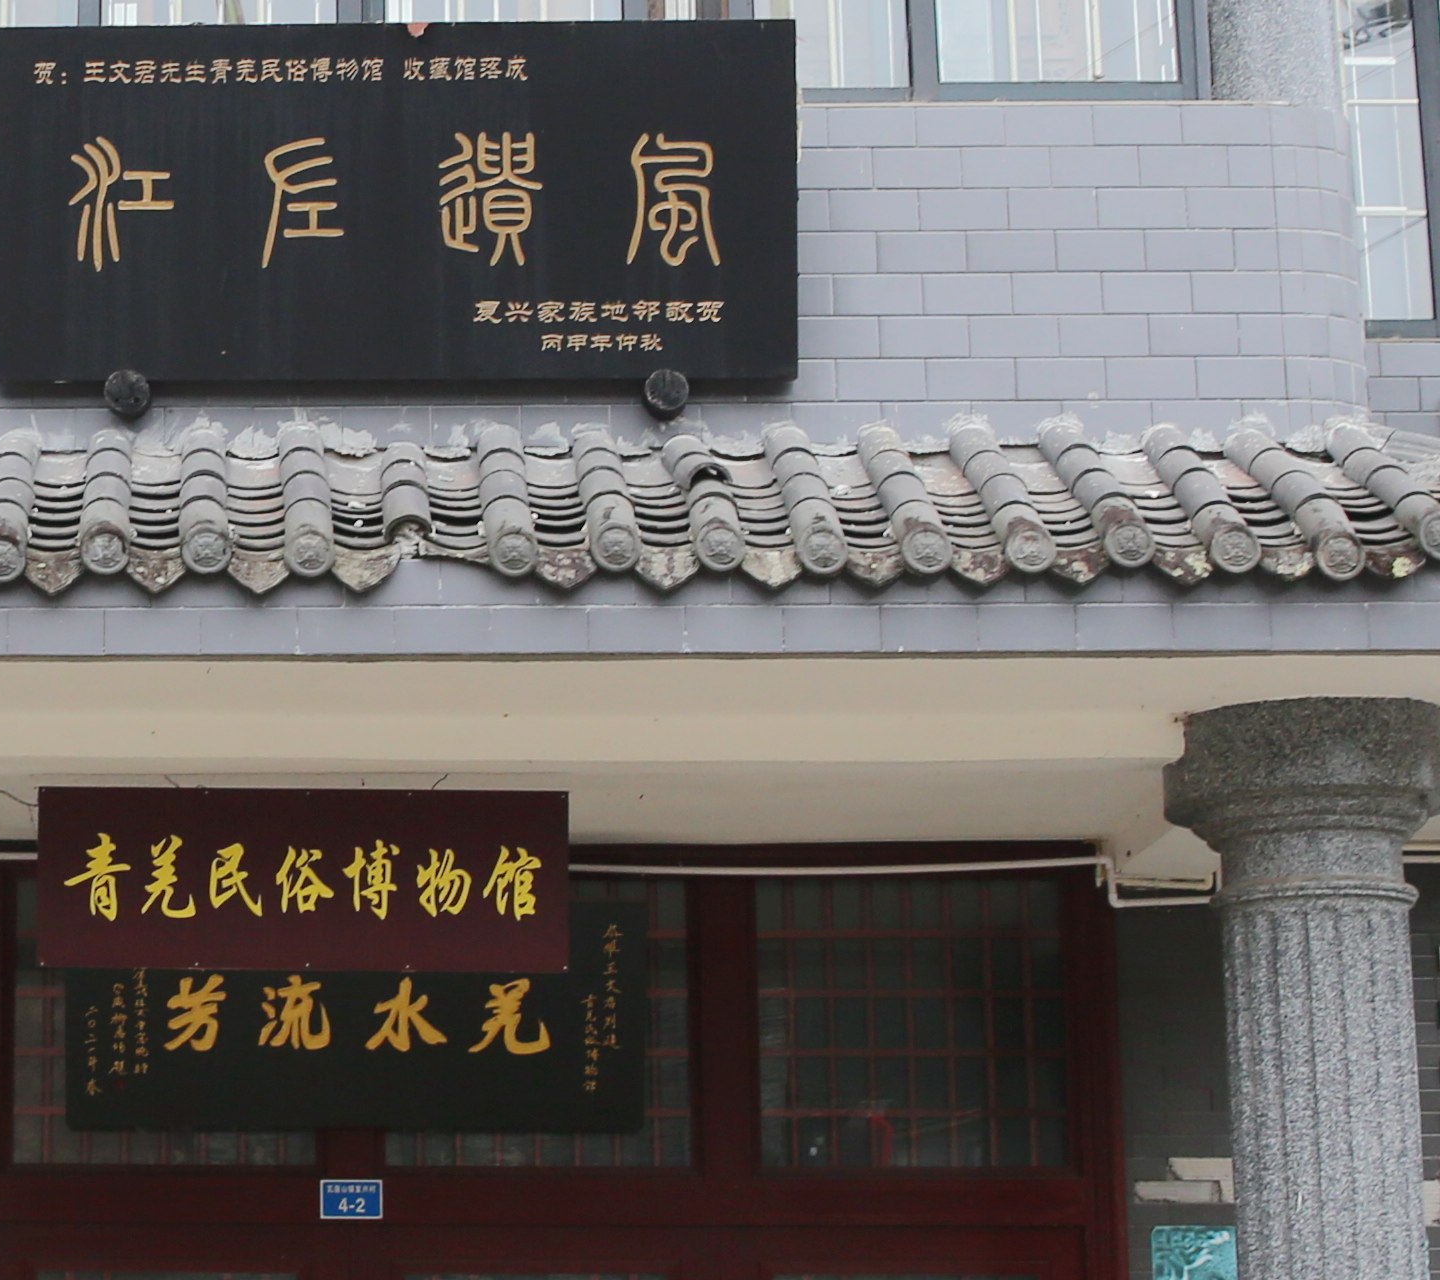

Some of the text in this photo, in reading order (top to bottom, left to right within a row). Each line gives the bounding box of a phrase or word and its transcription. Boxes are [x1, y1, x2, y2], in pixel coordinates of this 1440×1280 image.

[63, 832, 543, 922] 青羌民俗博物馆
[338, 1197, 366, 1213] 4-2
